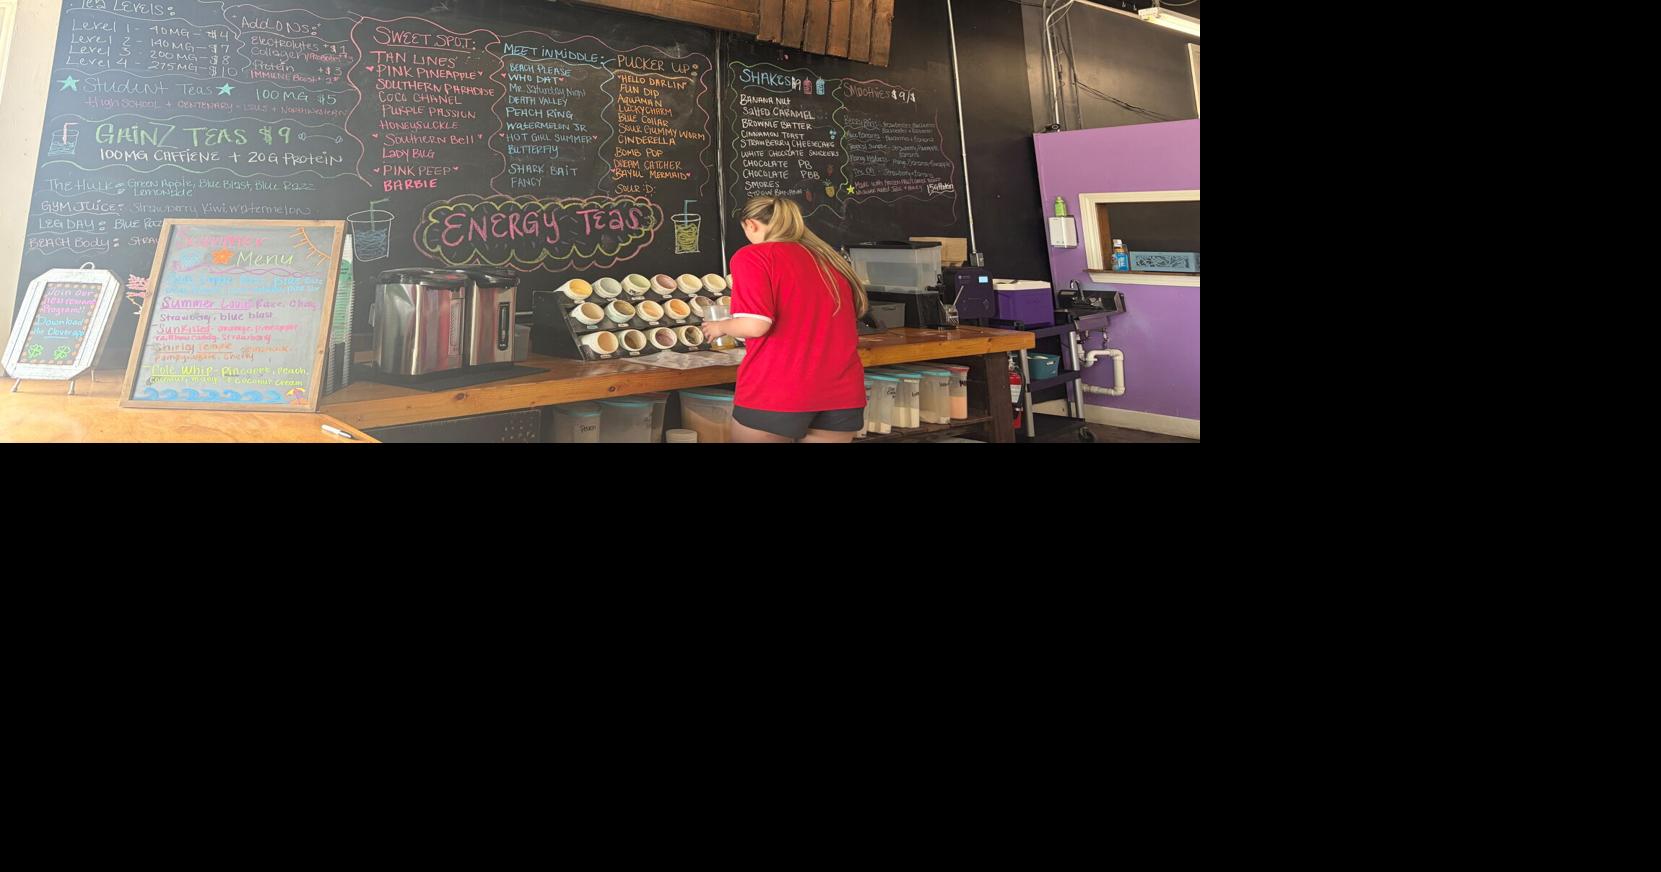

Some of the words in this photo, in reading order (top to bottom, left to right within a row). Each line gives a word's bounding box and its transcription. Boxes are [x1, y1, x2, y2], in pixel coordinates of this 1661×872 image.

[72, 19, 116, 32] Level
[71, 33, 111, 44] Level
[122, 37, 131, 46] 2
[373, 26, 432, 45] SWEET
[69, 45, 110, 56] Level
[504, 43, 538, 55] MEET
[66, 56, 110, 67] Level
[116, 57, 127, 68] 4
[369, 50, 407, 63] TAN
[413, 54, 457, 69] LINES
[617, 54, 665, 71] PUCKER
[376, 64, 414, 77] PINK
[416, 68, 477, 80] PINEAPPLE
[510, 64, 534, 74] BEACH
[537, 64, 572, 77] PLEASE
[508, 73, 532, 82] WHO
[537, 76, 558, 85] DAT
[376, 79, 441, 92] SOUTHERN
[444, 84, 495, 97] PARADISE
[620, 84, 640, 93] FUN
[643, 88, 660, 98] DIP
[509, 96, 536, 105] DEATH
[540, 97, 568, 108] VALLEY
[740, 93, 774, 106] BANANA
[382, 104, 424, 117] PURPLE
[429, 107, 476, 119] PASSION
[506, 107, 542, 118] PEACH
[773, 106, 816, 120] CARAMEL
[573, 123, 588, 133] JR
[742, 118, 779, 129] BROWNIE
[781, 121, 813, 131] BATTER
[183, 126, 248, 147] TEAS
[506, 133, 529, 142] HOT
[531, 133, 552, 142] GIRL
[554, 133, 592, 144] SUMMER
[617, 134, 676, 146] CINDERELLA
[679, 130, 705, 141] WORM
[741, 130, 779, 139] CINNAMON
[781, 132, 805, 140] TOAST
[412, 149, 435, 159] BUG
[614, 146, 641, 157] BOMB
[646, 148, 664, 157] POP
[741, 150, 764, 158] WHITE
[508, 163, 545, 175] SHARK
[613, 159, 640, 169] DREAM
[644, 160, 681, 170] CATCHER
[743, 160, 789, 168] CHOCOLATE
[798, 160, 813, 169] PB
[383, 165, 415, 177] PINK
[418, 166, 451, 176] PEEP
[743, 169, 789, 179] CHOCOLATE
[199, 179, 222, 188] Blue
[255, 180, 281, 191] Blue
[383, 179, 438, 192] BARBIE
[511, 177, 542, 188] FANCY
[745, 181, 780, 190] SMORES
[441, 211, 560, 247] ENERGY
[237, 250, 293, 266] Menu
